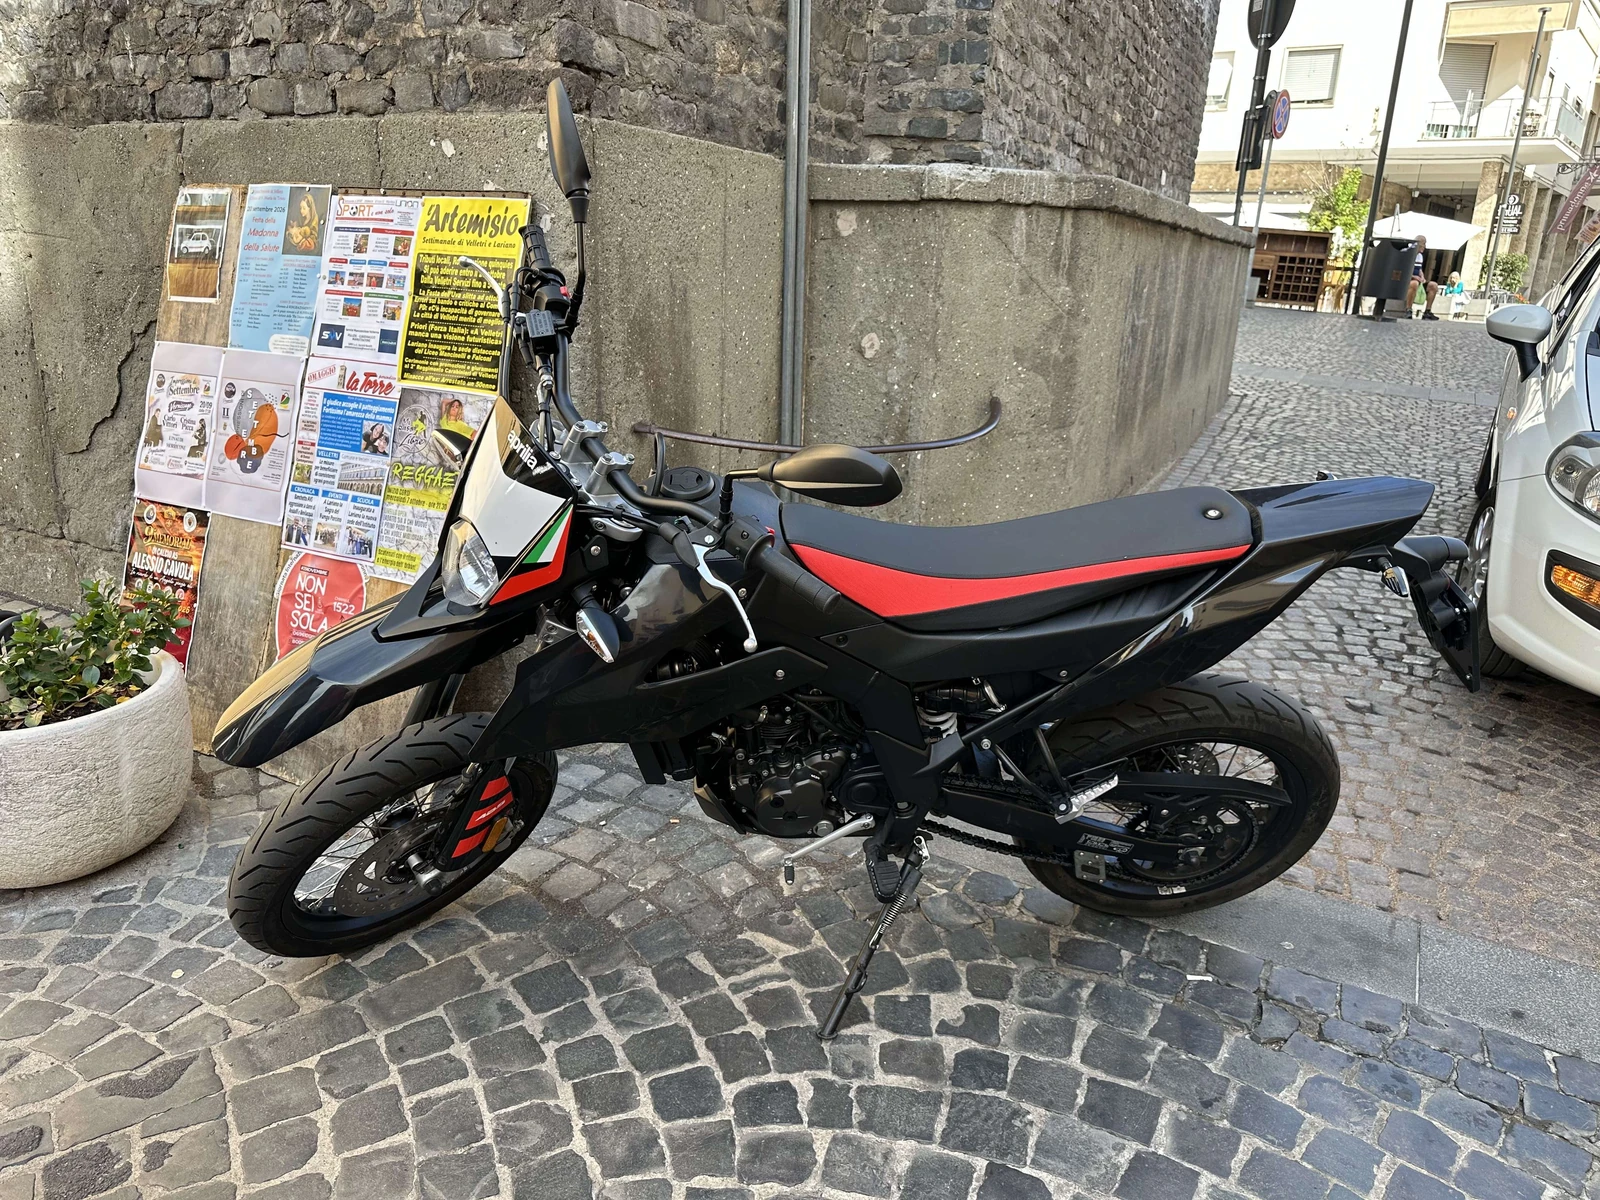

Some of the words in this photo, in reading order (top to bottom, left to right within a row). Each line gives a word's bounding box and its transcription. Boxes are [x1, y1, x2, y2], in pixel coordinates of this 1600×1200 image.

[248, 228, 279, 237] Madonna
[422, 237, 455, 246] Settimanale
[260, 244, 279, 252] Salute
[420, 254, 435, 264] Tributi
[489, 259, 513, 270] quinquies
[430, 266, 439, 275] può
[440, 267, 458, 275] aderire
[421, 275, 433, 284] Dalla
[434, 276, 451, 285] Velletri
[453, 278, 471, 287] Servizi
[472, 279, 482, 288] fino
[459, 299, 479, 307] critiche
[440, 305, 467, 315] incapacità
[440, 313, 458, 321] Velletri
[409, 330, 429, 338] manca
[443, 332, 465, 341] visione
[410, 322, 428, 330] Priori
[428, 323, 447, 332] (Forza
[449, 325, 469, 335] Italia):
[480, 328, 503, 338] Velletri
[428, 342, 451, 352] inaugura
[472, 347, 500, 356] distaccata
[439, 351, 466, 359] Mancinelli
[472, 354, 492, 362] Falconi
[440, 361, 466, 370] promozioni
[471, 364, 498, 373] giuramenti
[308, 366, 336, 382] OMAGGIO
[403, 372, 424, 380] Minacce
[441, 376, 466, 386] Arrestato
[445, 368, 472, 376] Carabinieri
[478, 371, 497, 379] Velletri
[346, 371, 359, 391] la
[359, 372, 395, 396] Torre
[168, 384, 200, 396] Settembre
[323, 406, 343, 415] Fortissima
[342, 401, 358, 410] accoglie
[362, 404, 394, 413] patteggiamento
[180, 416, 196, 425] Cristina
[318, 450, 338, 459] VELLETRI
[507, 430, 538, 470] aprilia
[294, 486, 315, 495] CRONACA
[131, 552, 164, 576] ALESSIO
[164, 559, 194, 581] CAVOLA
[295, 573, 327, 596] NON
[294, 592, 314, 612] SEI
[178, 606, 190, 614] 026
[333, 602, 355, 615] 1522
[290, 610, 328, 633] SOLA
